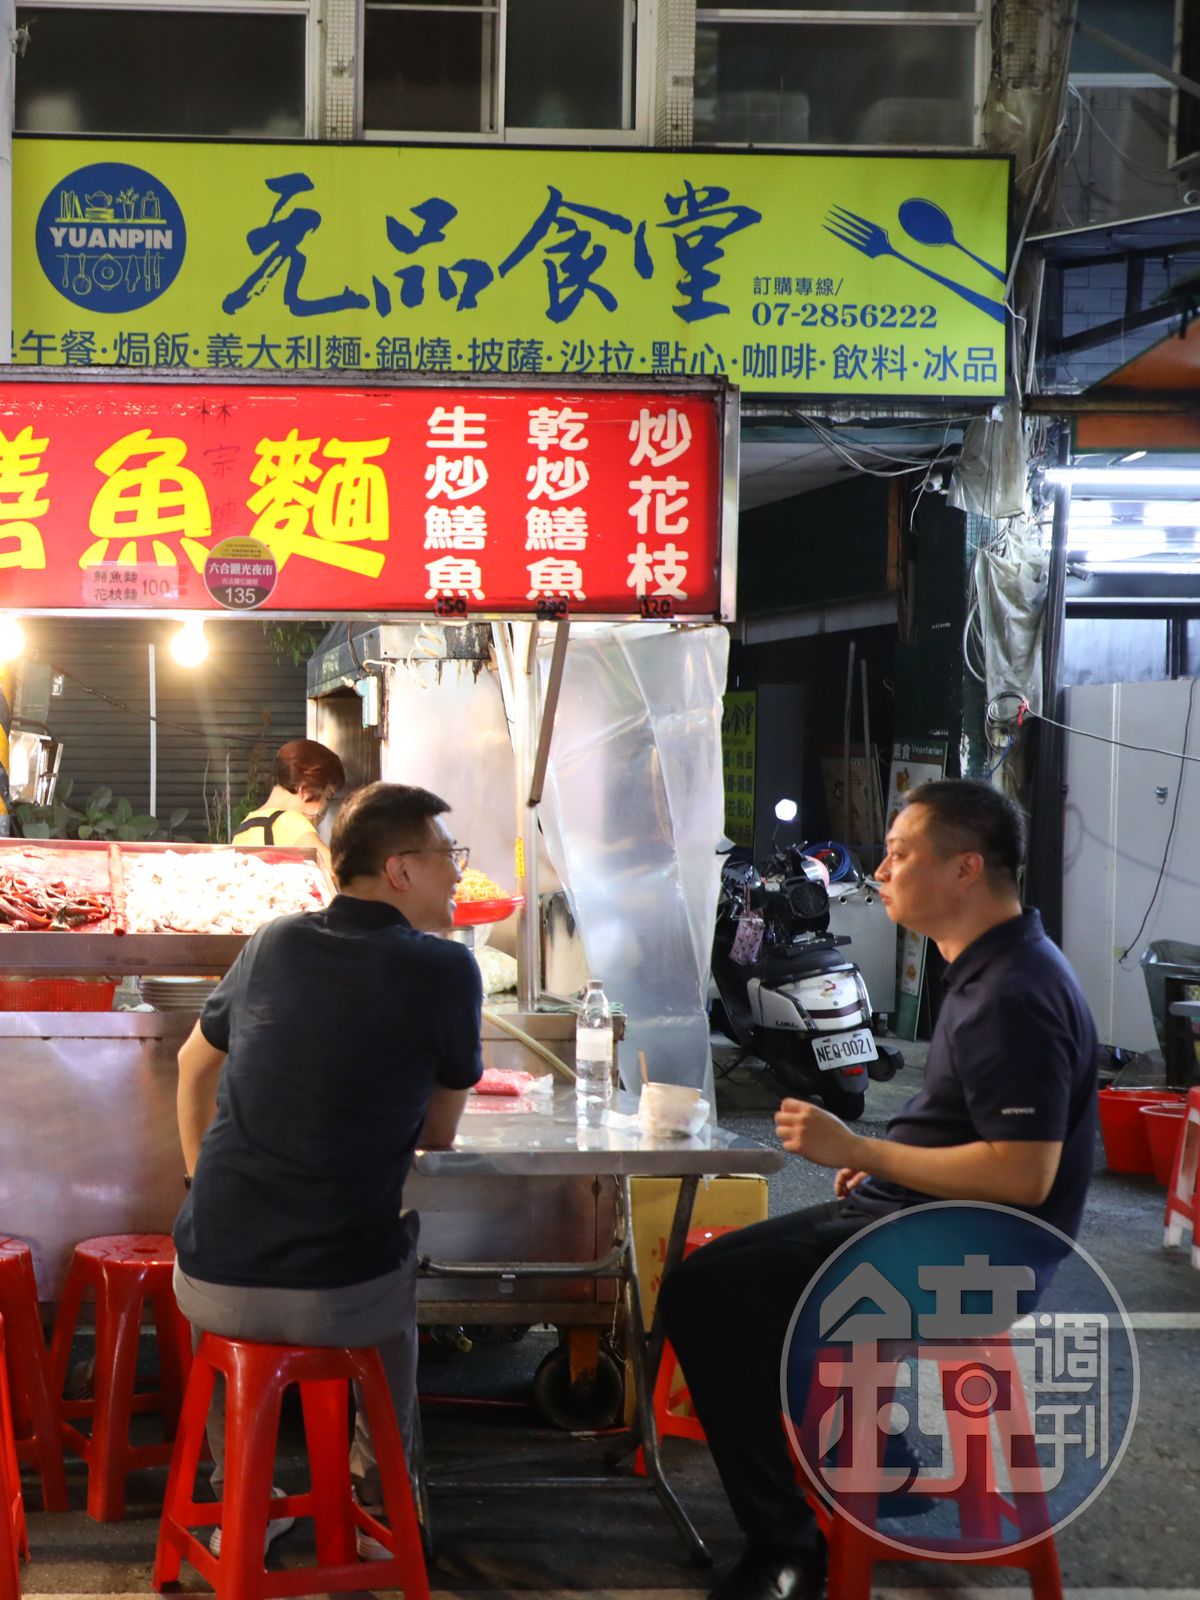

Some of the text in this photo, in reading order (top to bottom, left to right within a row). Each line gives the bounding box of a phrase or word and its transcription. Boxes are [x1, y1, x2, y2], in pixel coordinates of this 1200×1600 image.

[49, 226, 173, 249] YUANPIN
[222, 173, 762, 322] 元品食堂
[753, 276, 844, 296] 訂購專線/
[752, 302, 937, 328] 07-2856222
[423, 406, 489, 600] 生炒鱔魚
[525, 406, 590, 600] 乾炒鱔魚
[627, 408, 692, 600] 炒花枝
[142, 579, 170, 597] 100
[225, 587, 256, 603] 135
[816, 1037, 872, 1062] NEQ-0021
